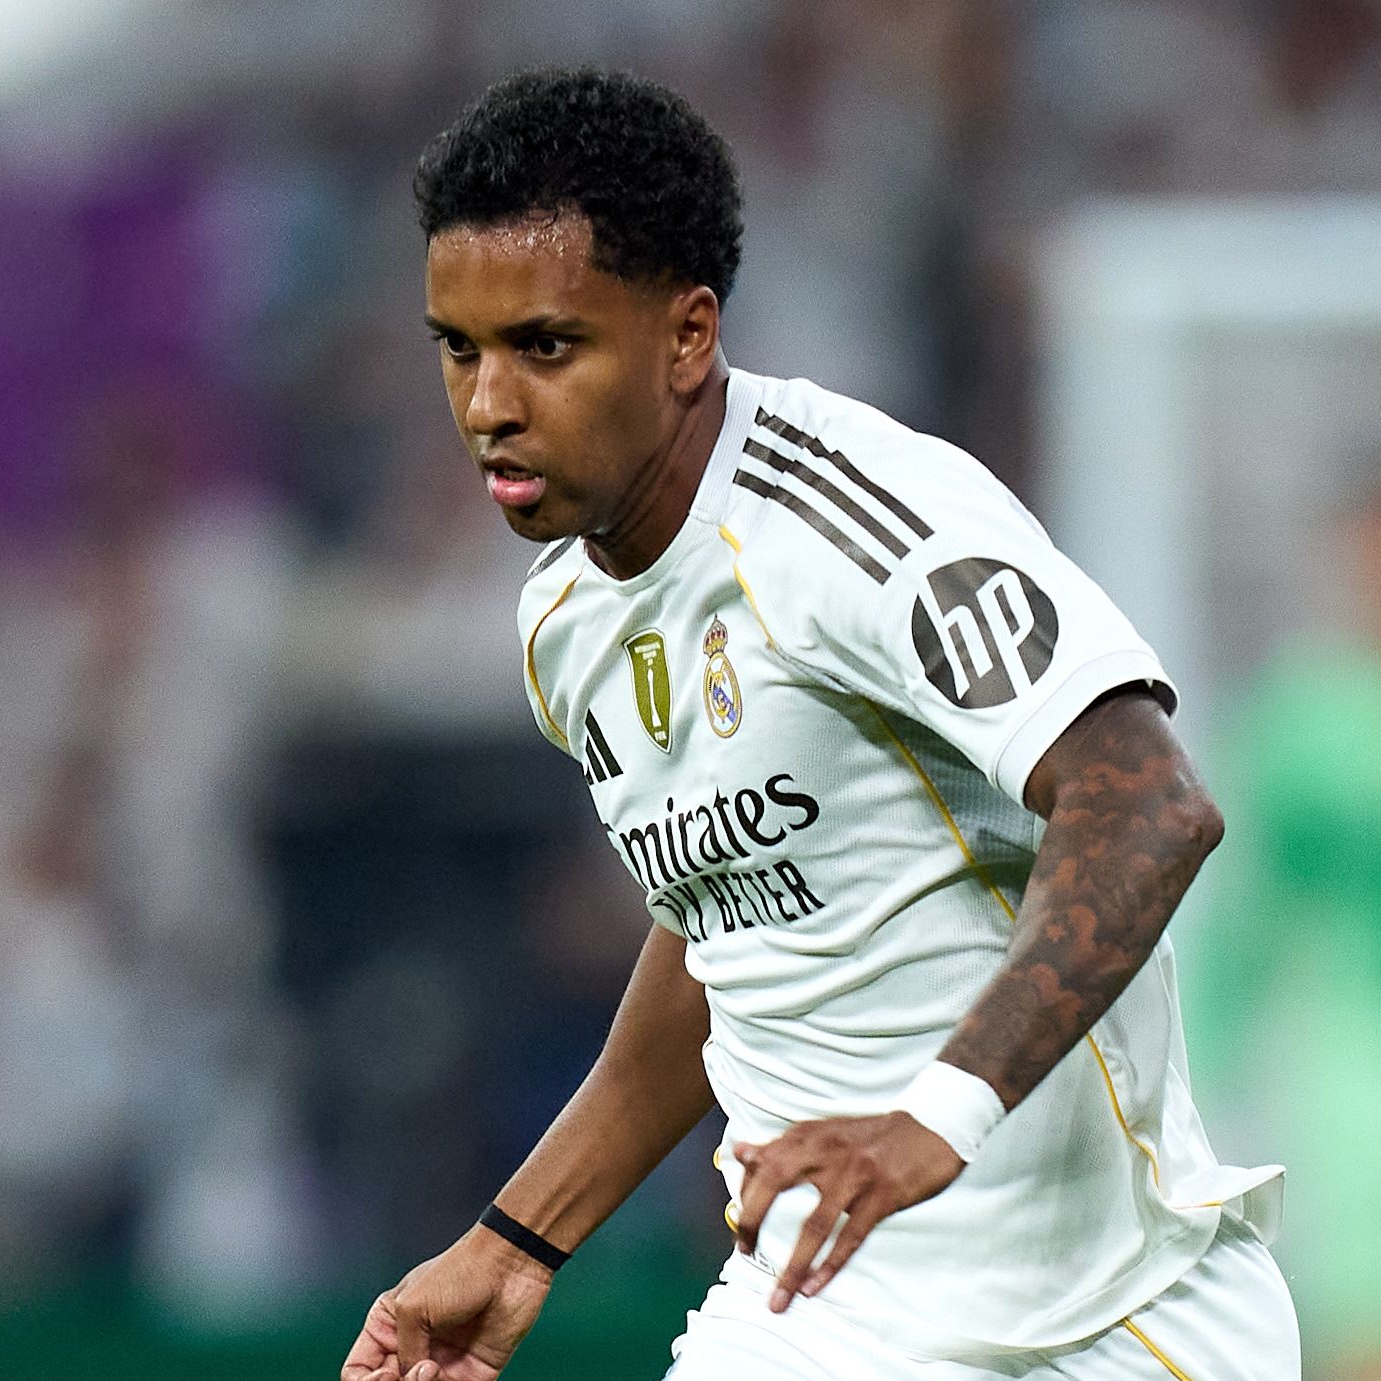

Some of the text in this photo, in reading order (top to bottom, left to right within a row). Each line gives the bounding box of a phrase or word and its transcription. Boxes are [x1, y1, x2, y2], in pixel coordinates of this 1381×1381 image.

[915, 564, 1036, 703] hp
[619, 773, 820, 890] mirates
[700, 860, 825, 933] BETTER
